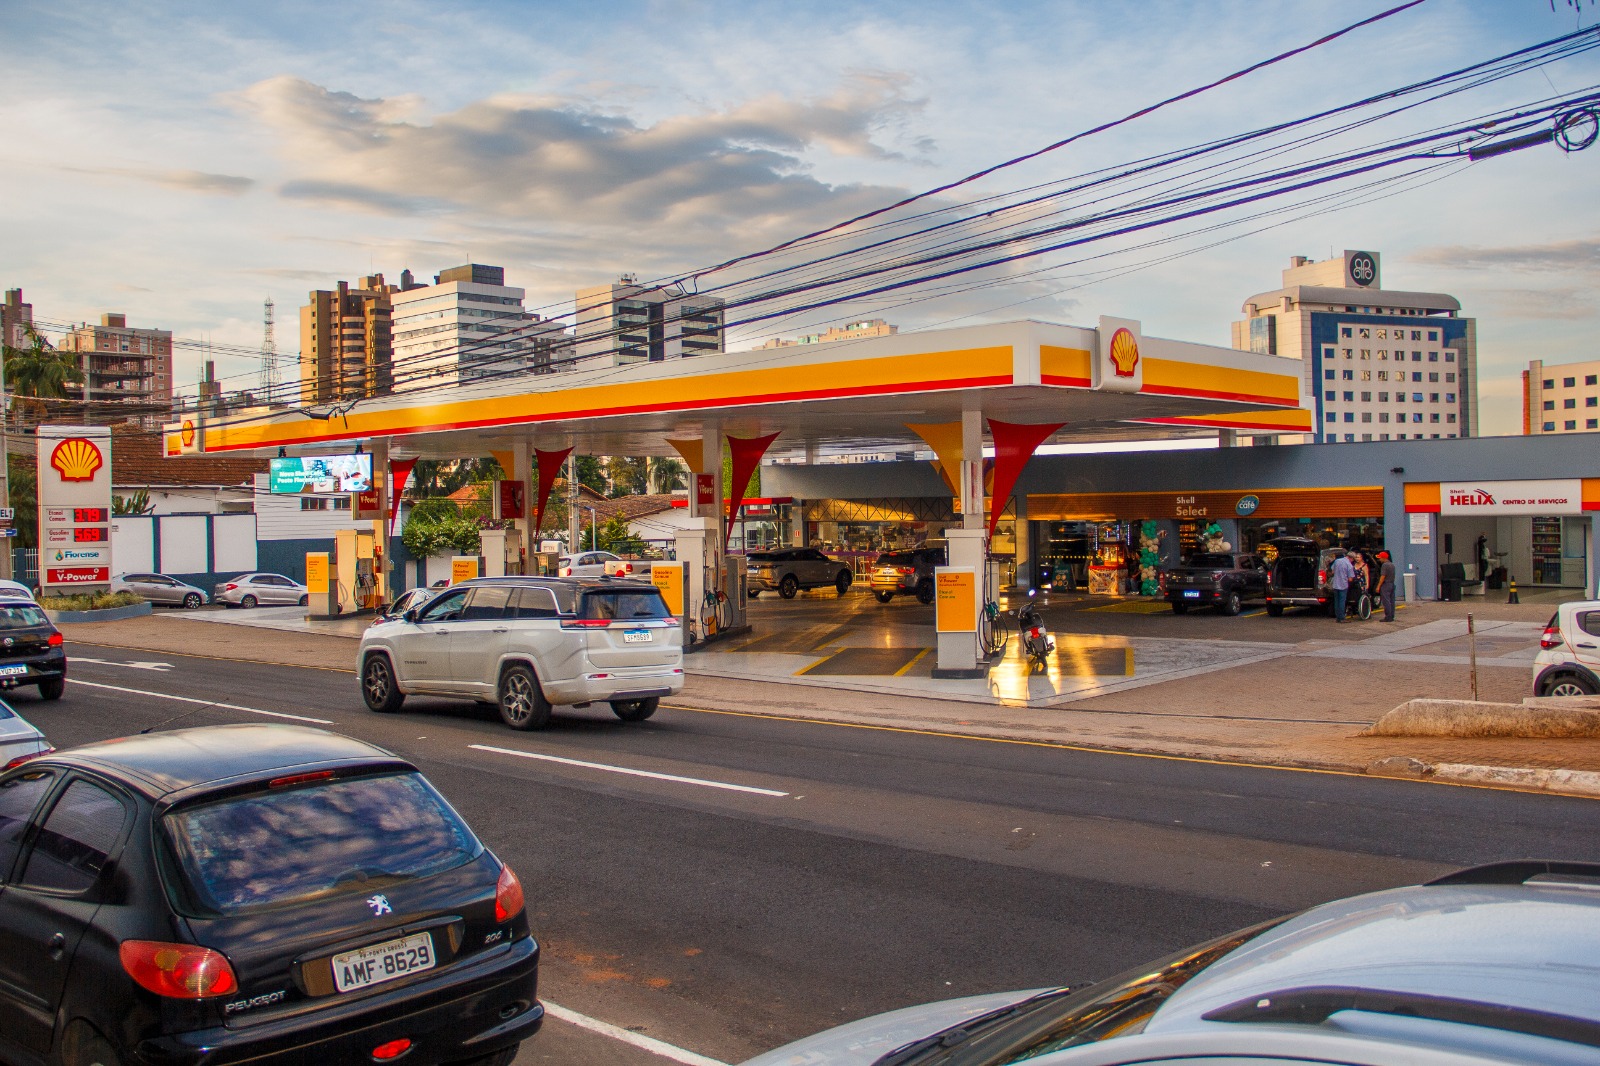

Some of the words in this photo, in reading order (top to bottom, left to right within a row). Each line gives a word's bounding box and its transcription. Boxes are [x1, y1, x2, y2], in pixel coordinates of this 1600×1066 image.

[955, 500, 962, 510] 2
[1176, 496, 1195, 504] Shell
[1239, 500, 1256, 509] café
[1450, 494, 1495, 506] HELIX
[1176, 505, 1208, 516] Select
[56, 573, 98, 581] V-Power
[225, 990, 286, 1013] PEUGEOT
